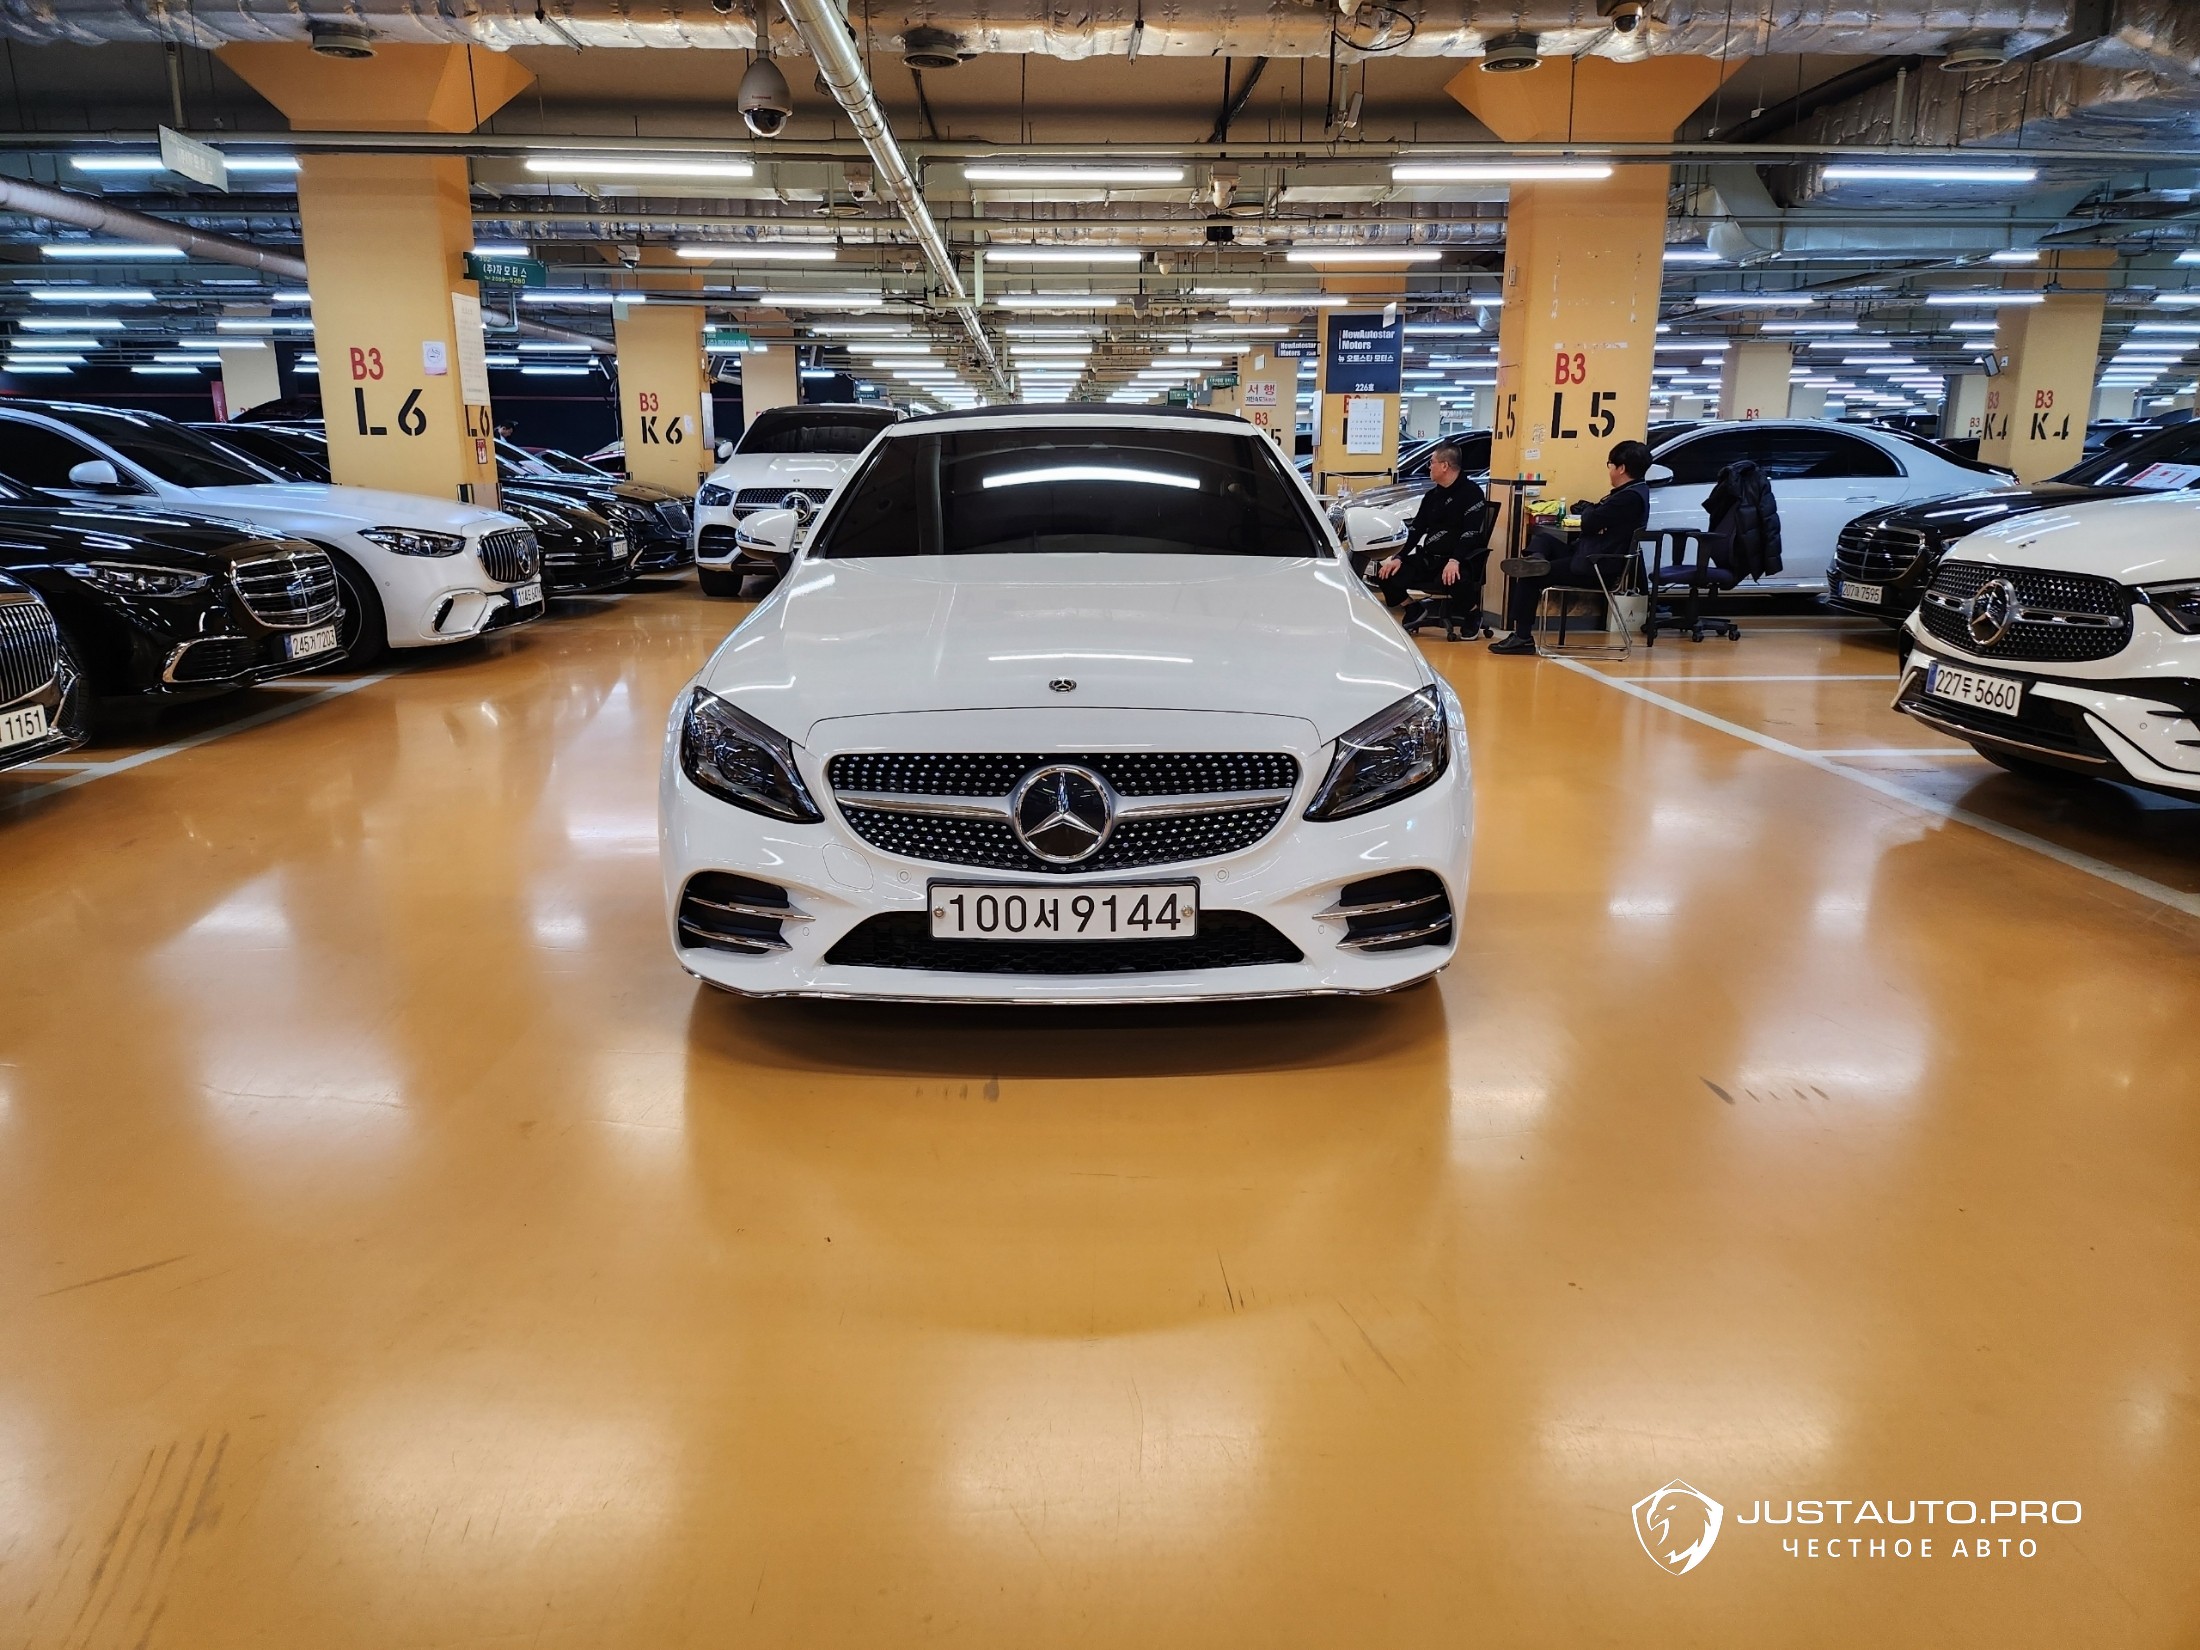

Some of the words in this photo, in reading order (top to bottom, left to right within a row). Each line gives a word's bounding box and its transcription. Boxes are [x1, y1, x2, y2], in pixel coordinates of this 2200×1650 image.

[1342, 329, 1395, 339] NewAutostar
[1341, 340, 1372, 350] Motors
[350, 347, 384, 380] B3
[1555, 352, 1586, 385] B3
[1355, 383, 1375, 392] 226호
[639, 392, 659, 412] B3
[1988, 391, 2000, 409] B3
[2035, 389, 2054, 409] B3
[1255, 412, 1268, 426] B3
